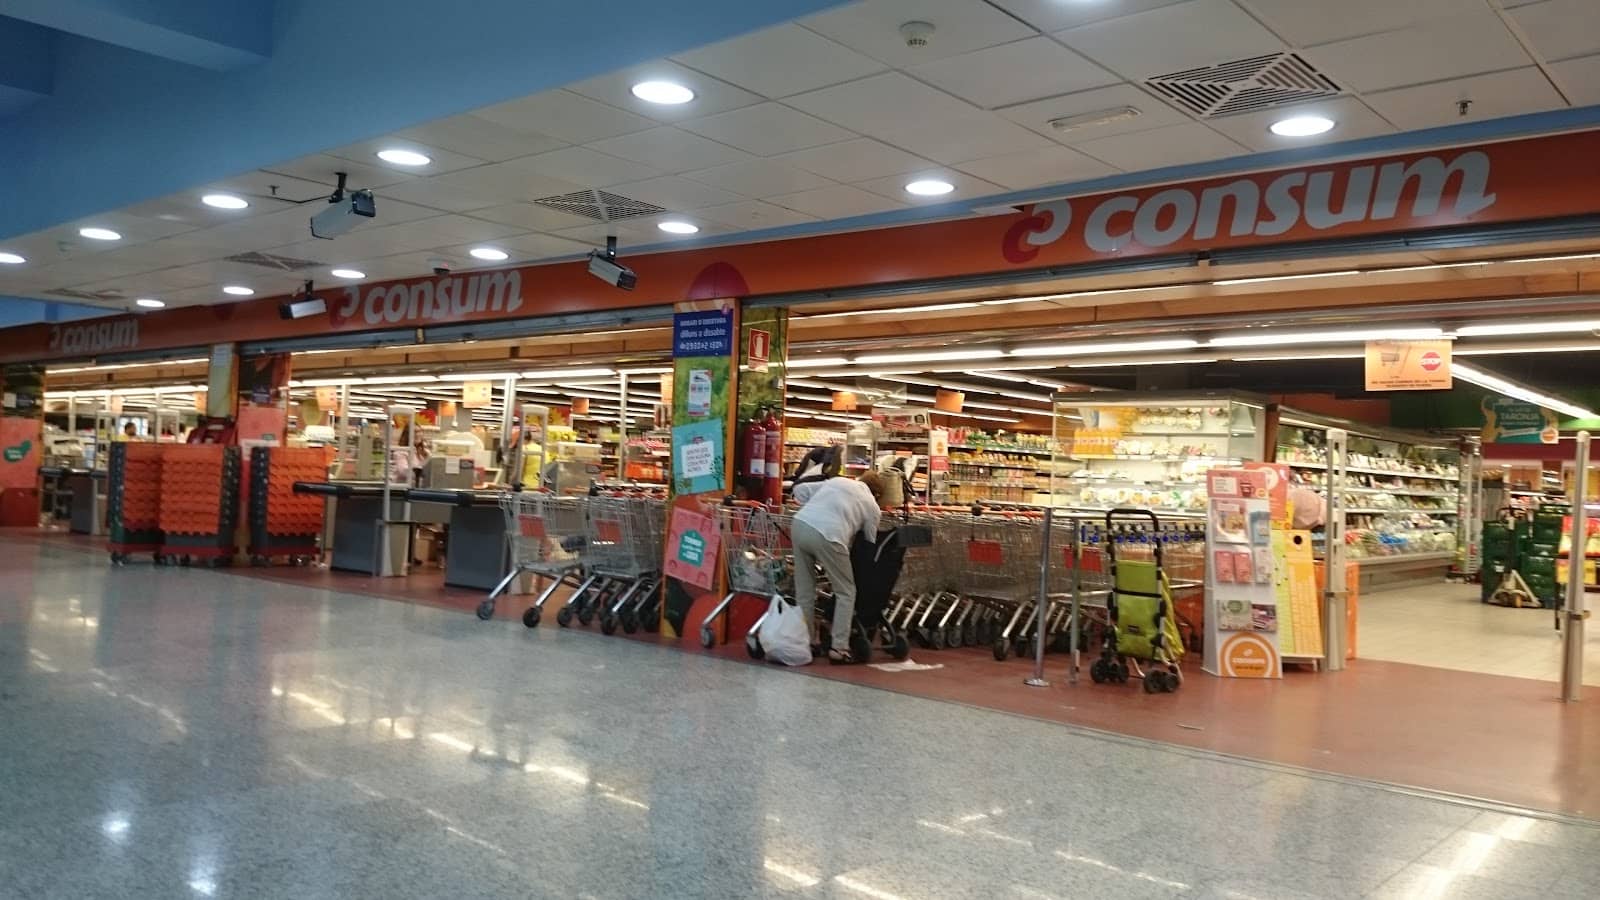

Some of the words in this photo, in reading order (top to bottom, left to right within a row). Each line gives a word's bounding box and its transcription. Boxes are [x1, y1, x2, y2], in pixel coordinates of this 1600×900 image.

[1084, 151, 1497, 253] consum
[363, 269, 523, 325] consum
[63, 318, 139, 355] consum
